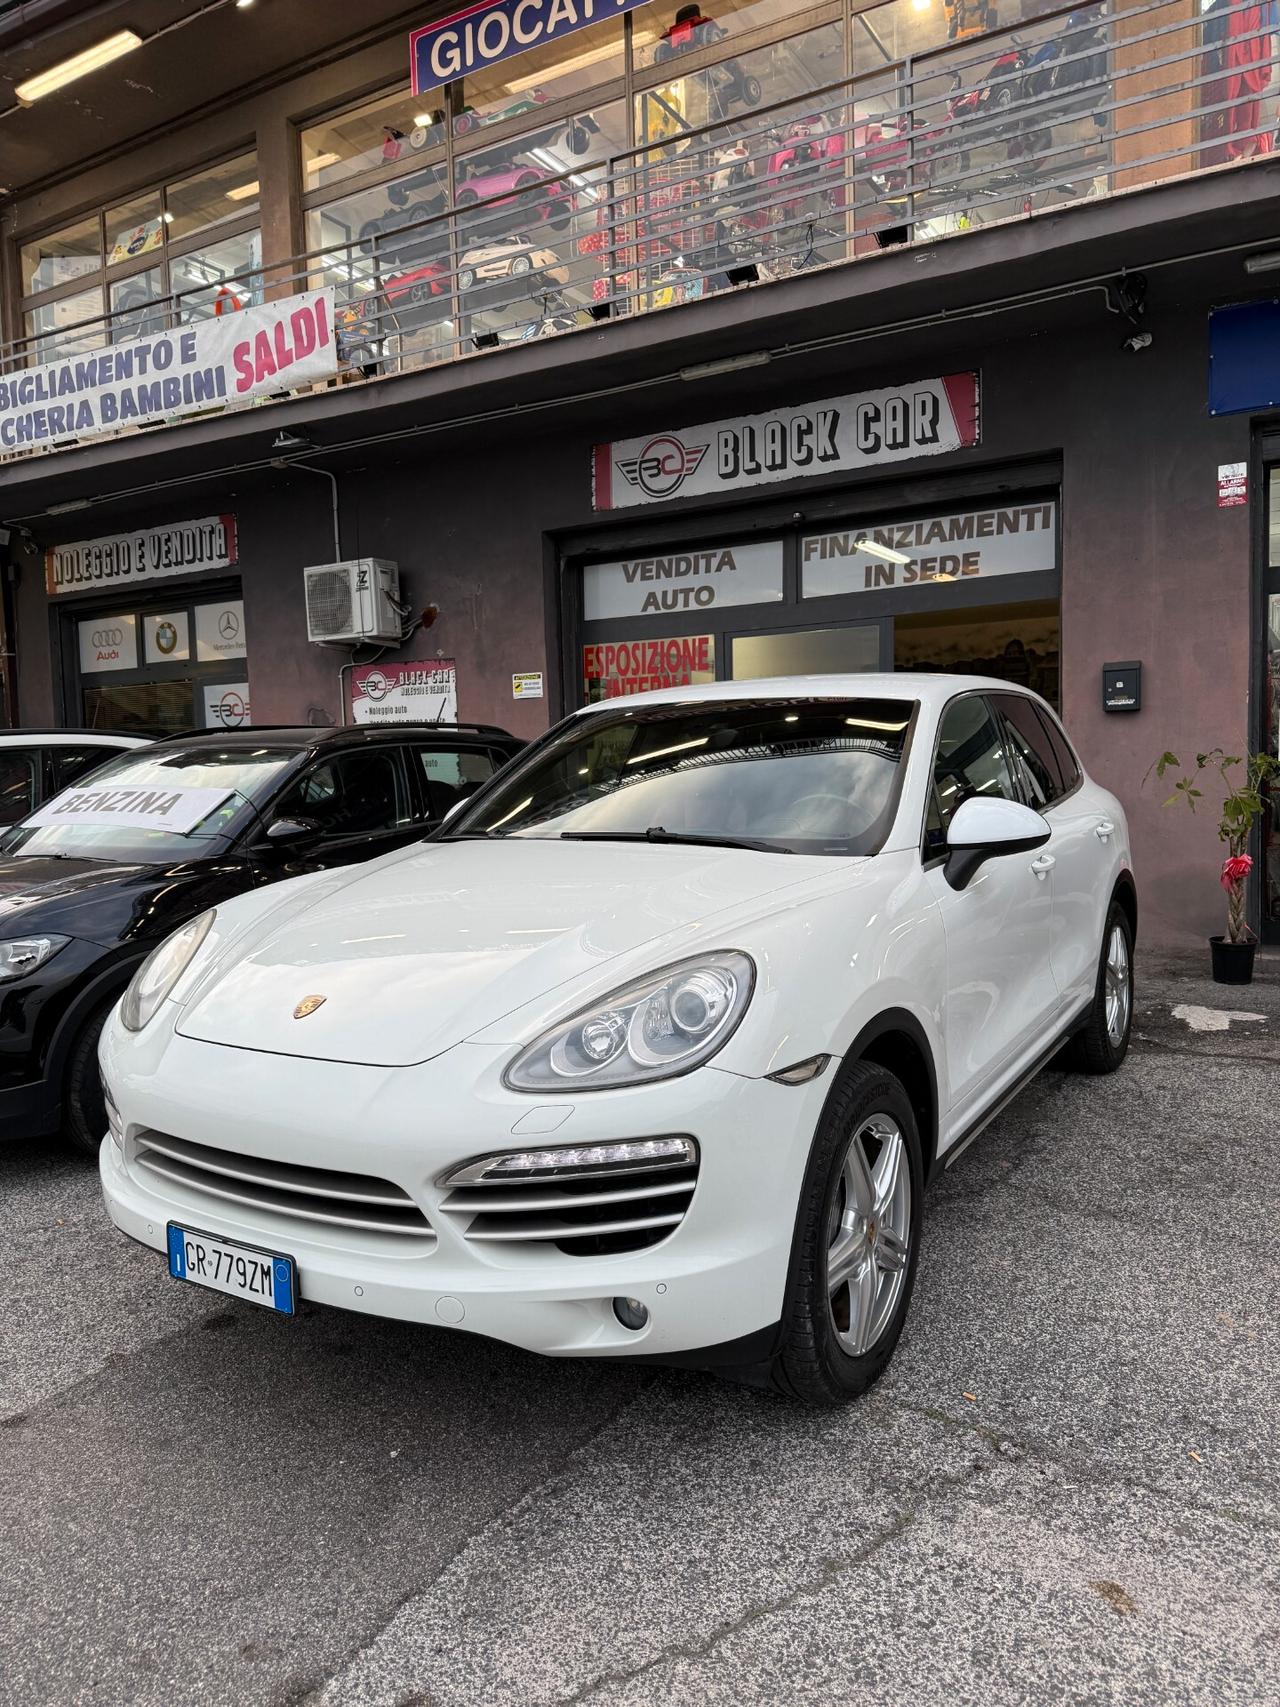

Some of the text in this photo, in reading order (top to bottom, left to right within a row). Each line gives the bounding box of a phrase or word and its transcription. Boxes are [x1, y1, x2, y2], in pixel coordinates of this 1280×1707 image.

[430, 0, 624, 78] GIOCA
[233, 296, 330, 393] SALDI
[0, 331, 197, 411] BIGLIAMENTO E
[0, 365, 227, 447] CHERIA BAMBINI
[717, 391, 941, 480] BLACK CAR
[52, 522, 229, 585] NOLEGGIO E VENDITA
[803, 505, 1051, 562] FINANZIAMENTI
[621, 550, 737, 583] VENDITA
[864, 551, 981, 589] IN SEDE
[640, 585, 715, 613] AUTO
[96, 650, 119, 661] Audi
[584, 637, 710, 679] ESPOSIZIONE
[399, 669, 451, 686] BLACK CAR
[369, 705, 408, 716] Noleggio auto
[52, 791, 184, 815] BENZINA
